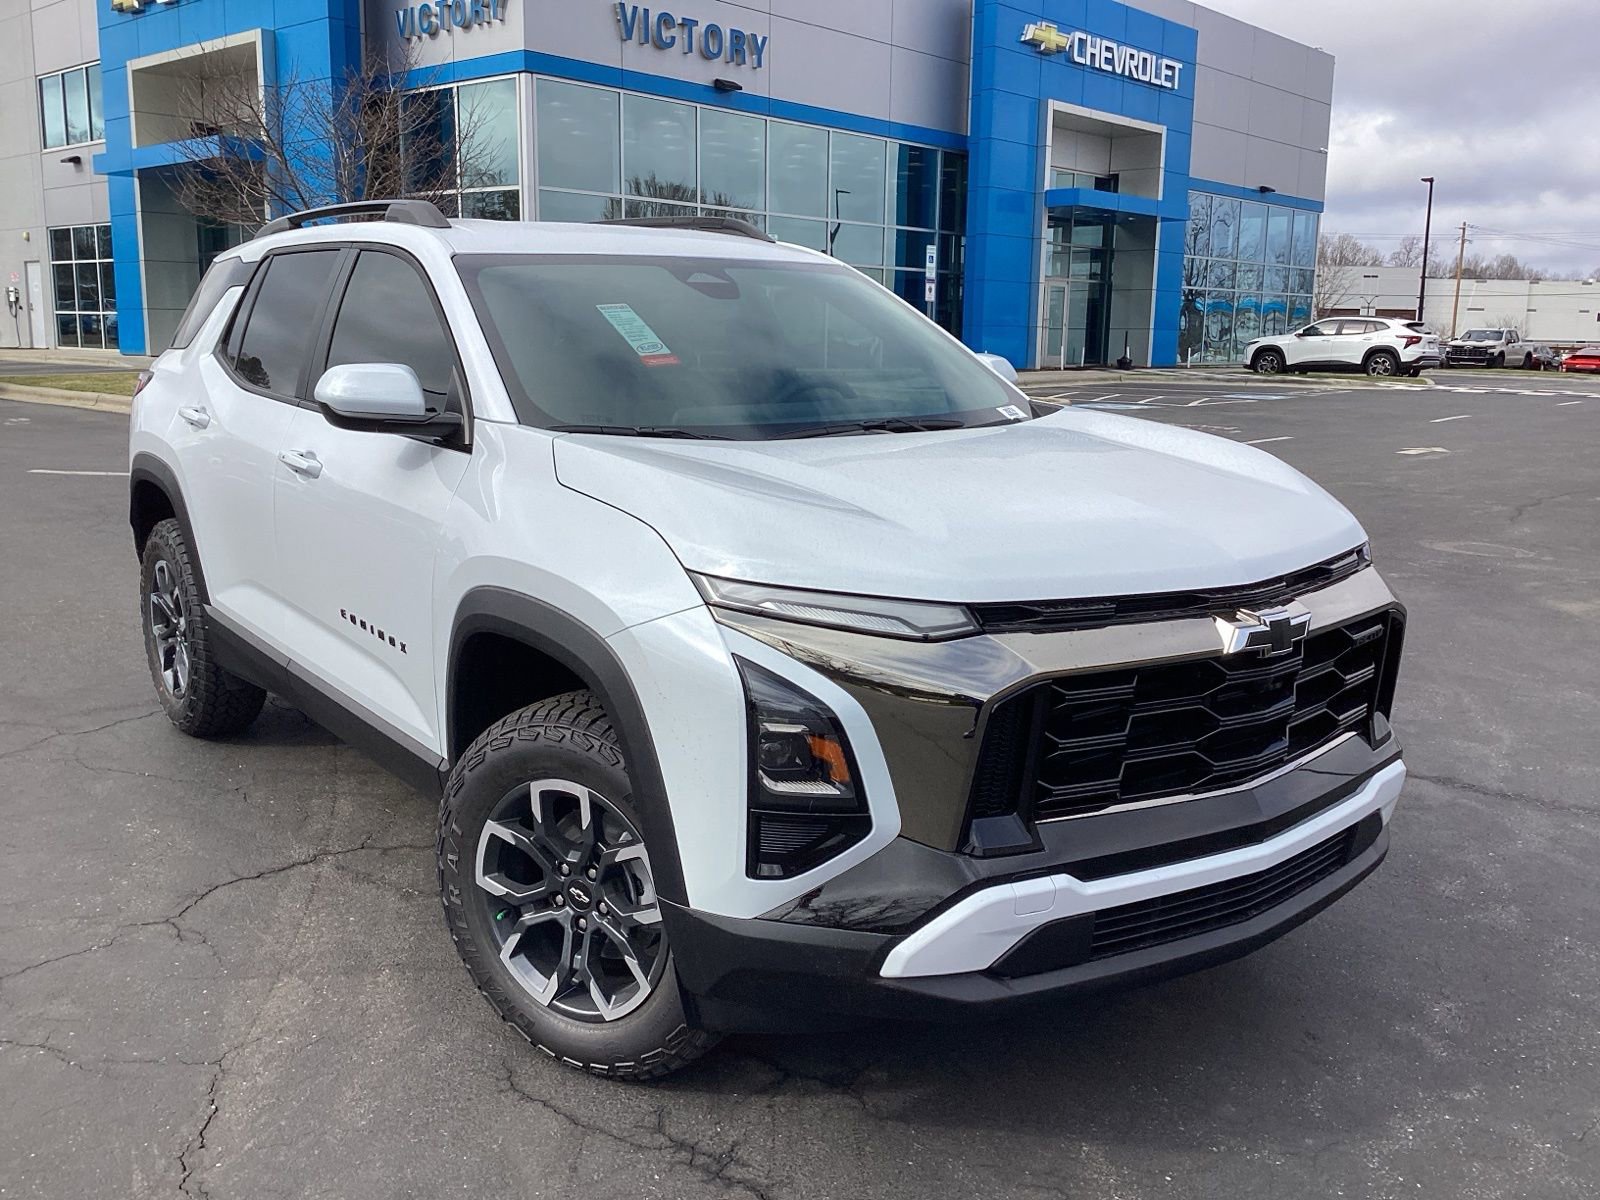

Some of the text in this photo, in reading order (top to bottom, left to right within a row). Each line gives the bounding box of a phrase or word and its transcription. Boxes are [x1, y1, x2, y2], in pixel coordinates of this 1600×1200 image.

[615, 2, 768, 69] VICTORY
[1072, 31, 1183, 90] CHEVROLET
[340, 608, 407, 655] EQUINOX
